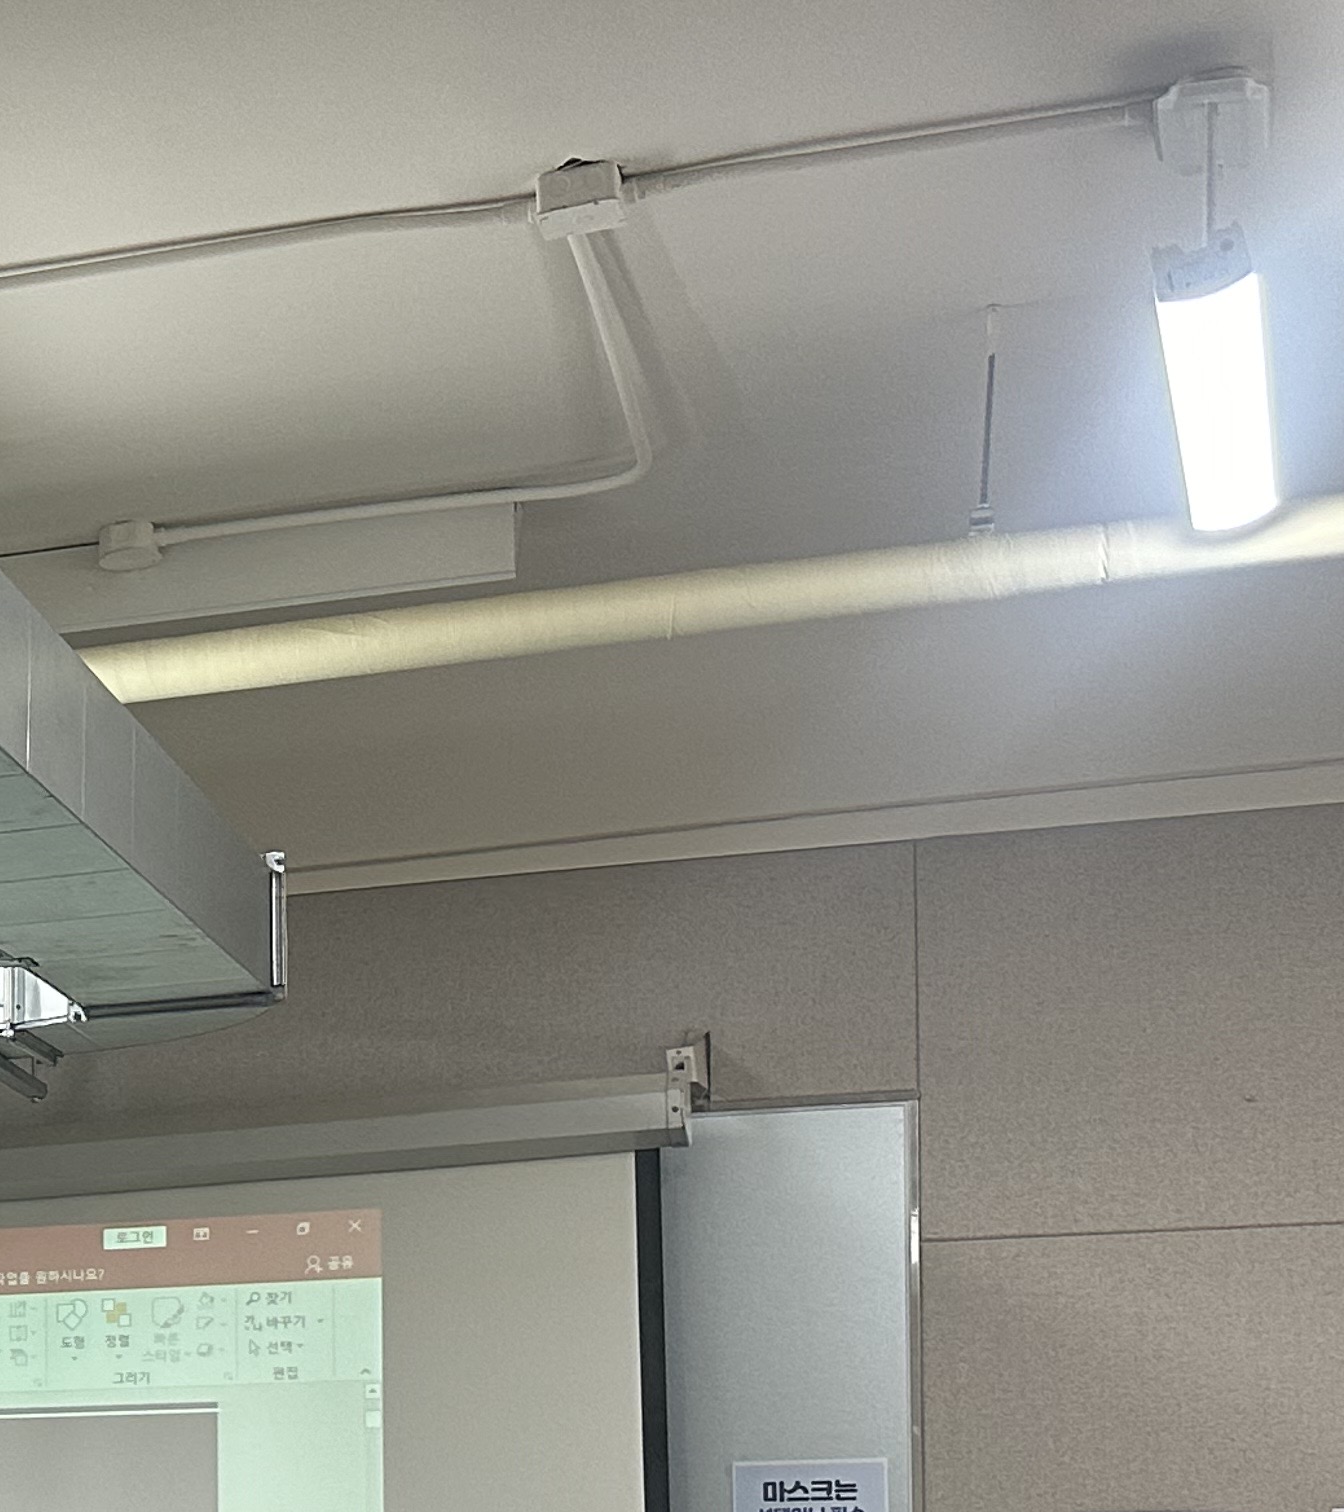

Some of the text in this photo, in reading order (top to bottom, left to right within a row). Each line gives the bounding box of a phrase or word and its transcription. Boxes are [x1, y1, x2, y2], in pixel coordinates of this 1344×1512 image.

[116, 1230, 154, 1244] 로그인
[35, 1267, 106, 1284] 원하시나요?
[265, 1291, 293, 1305] 찾기
[265, 1315, 306, 1330] 바꾸기
[62, 1335, 85, 1350] 도형
[104, 1334, 130, 1348] 정렬
[267, 1340, 293, 1354] 선택
[112, 1371, 151, 1385] 그리기
[273, 1366, 298, 1380] 편집
[762, 1479, 859, 1502] 마스크는
